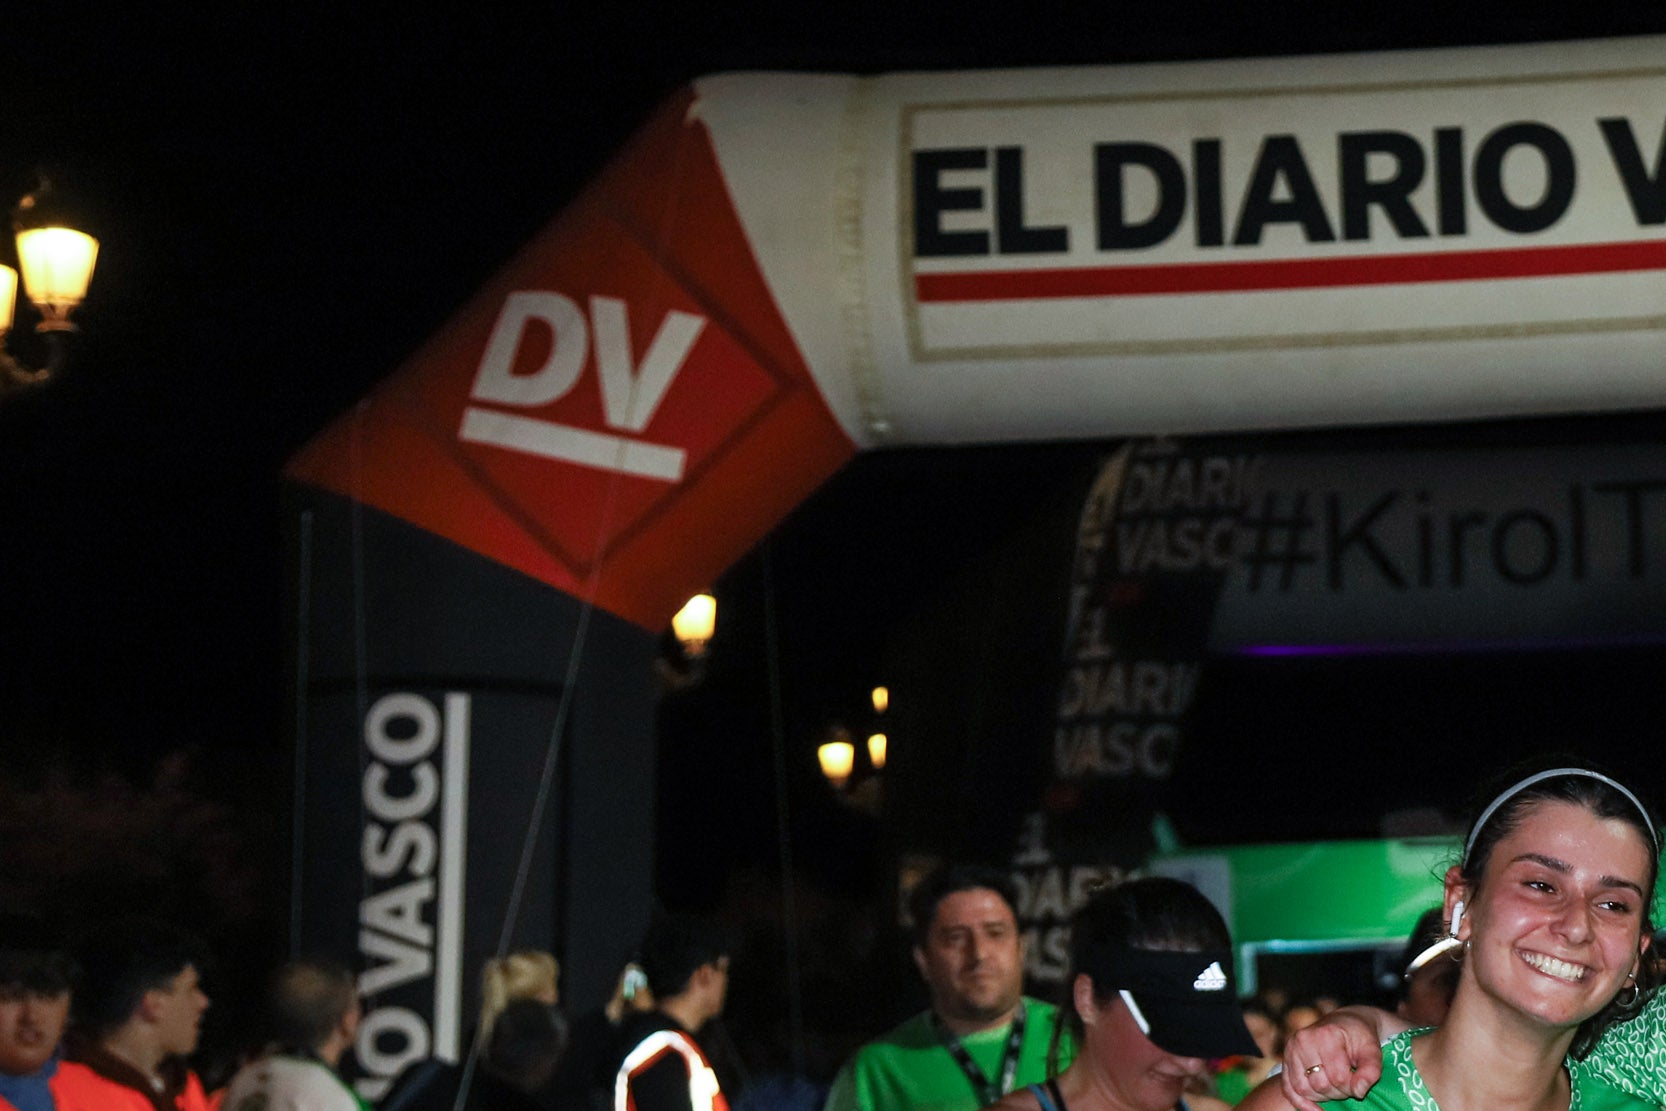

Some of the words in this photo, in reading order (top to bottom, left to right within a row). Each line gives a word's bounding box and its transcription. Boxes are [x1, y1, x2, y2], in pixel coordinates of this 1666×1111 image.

[912, 145, 1070, 259] EL
[1092, 121, 1577, 252] DIARIO
[471, 290, 708, 433] DV
[358, 693, 442, 997] VASCO
